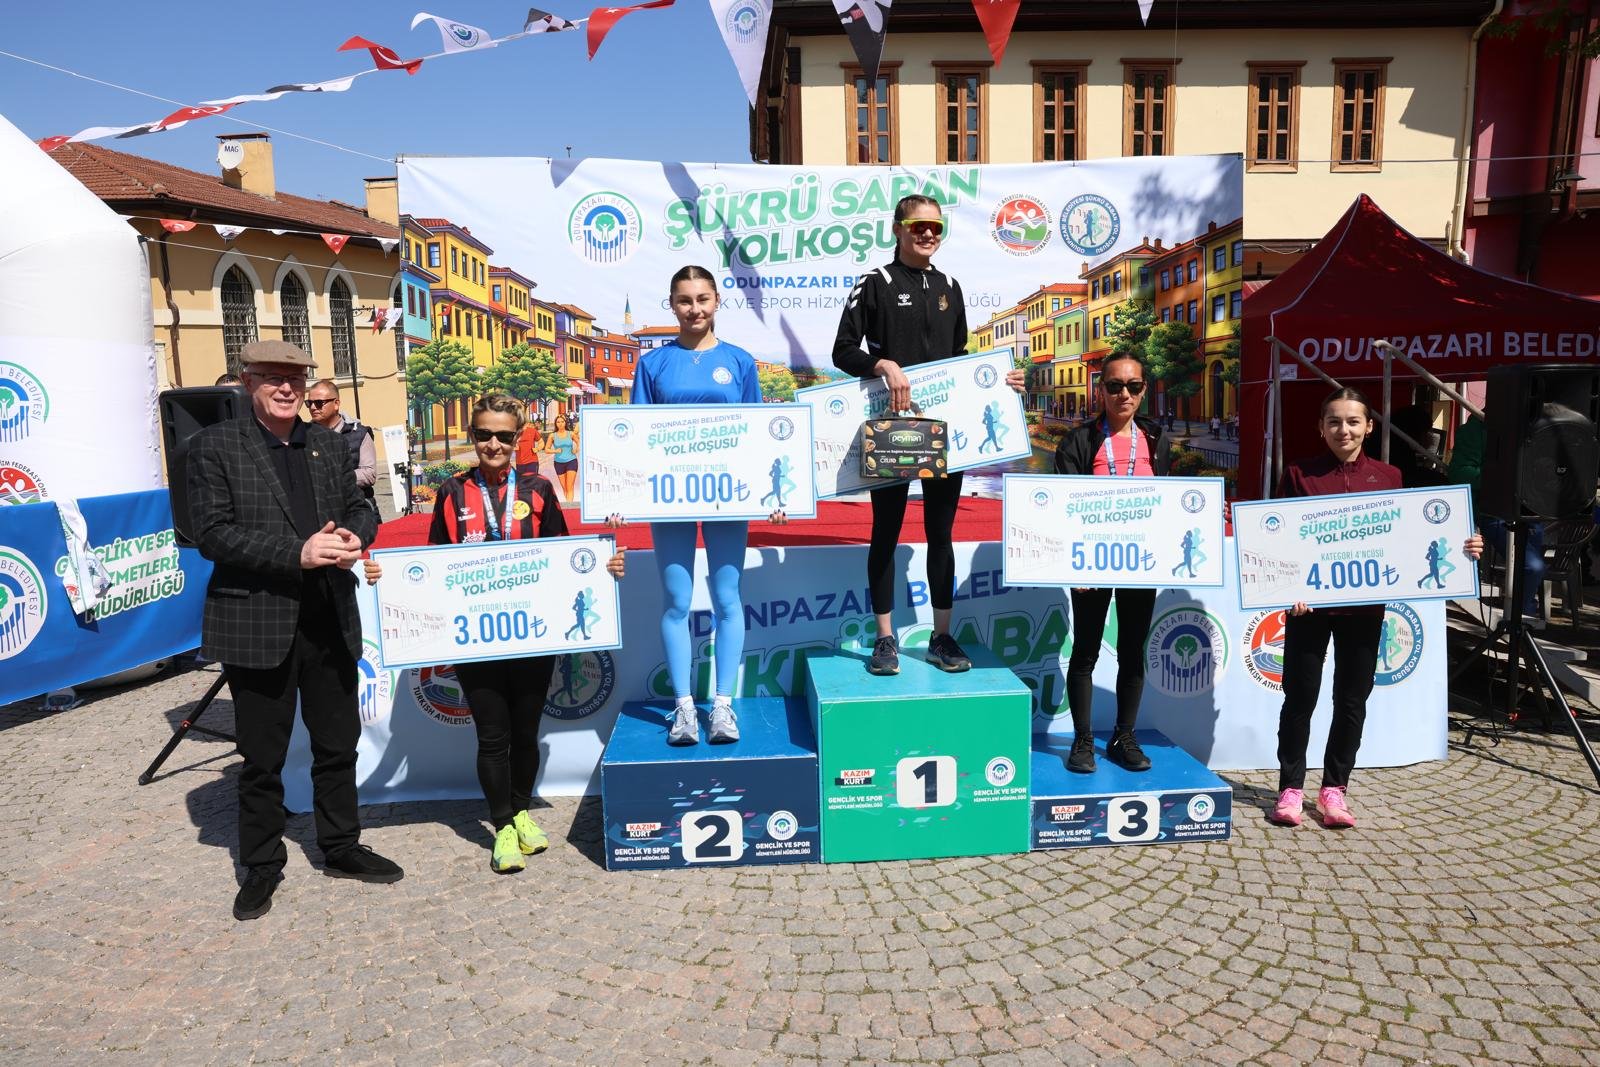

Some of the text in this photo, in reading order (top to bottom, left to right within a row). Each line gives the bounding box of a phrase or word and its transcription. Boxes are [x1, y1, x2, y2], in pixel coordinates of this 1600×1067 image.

[666, 174, 820, 247] ŞÜKRÜ
[716, 218, 950, 268] YOL KOŞU
[722, 275, 838, 290] ODUNPAZARI
[735, 297, 756, 310] VE
[760, 297, 802, 310] SPOR
[911, 377, 955, 401] SABAN
[647, 425, 696, 450] ŞÜKRÜ
[699, 423, 748, 439] SABAN
[663, 437, 739, 456] YOL KOŞUSU
[1066, 497, 1112, 518] ŞÜKRÜ
[1115, 495, 1162, 510] SABAN
[1081, 508, 1152, 525] YOL KOŞUSU
[1301, 507, 1350, 521] ODUNPAZARI
[1299, 514, 1348, 540] ŞÜKRÜ
[1352, 508, 1401, 527] SABAN
[1315, 523, 1392, 545] YOL KOŞUSU
[134, 536, 155, 554] VE
[109, 550, 179, 587] ZMETLERİ
[445, 564, 496, 591] ŞÜKRÜ
[499, 558, 549, 577] SABAN
[447, 556, 498, 571] ODUNPAZARI
[87, 571, 184, 622] MÜDÜRLÜĞÜ
[462, 573, 540, 597] YOL KOŞUSU
[1404, 609, 1422, 636] SABAN
[1149, 612, 1187, 669] ODUNPAZARI
[1413, 638, 1422, 656] YOL
[602, 671, 612, 688] YOL
[1244, 654, 1284, 692] TURKISH ATHLE
[1391, 655, 1418, 682] KOŞUSU
[413, 686, 472, 725] TURKISH ATHLETIC
[844, 777, 866, 785] KURT
[913, 760, 938, 803] 1
[1054, 813, 1076, 821] KURT
[1118, 800, 1149, 837] 3
[630, 830, 652, 838] KURT
[693, 814, 731, 858] 2
